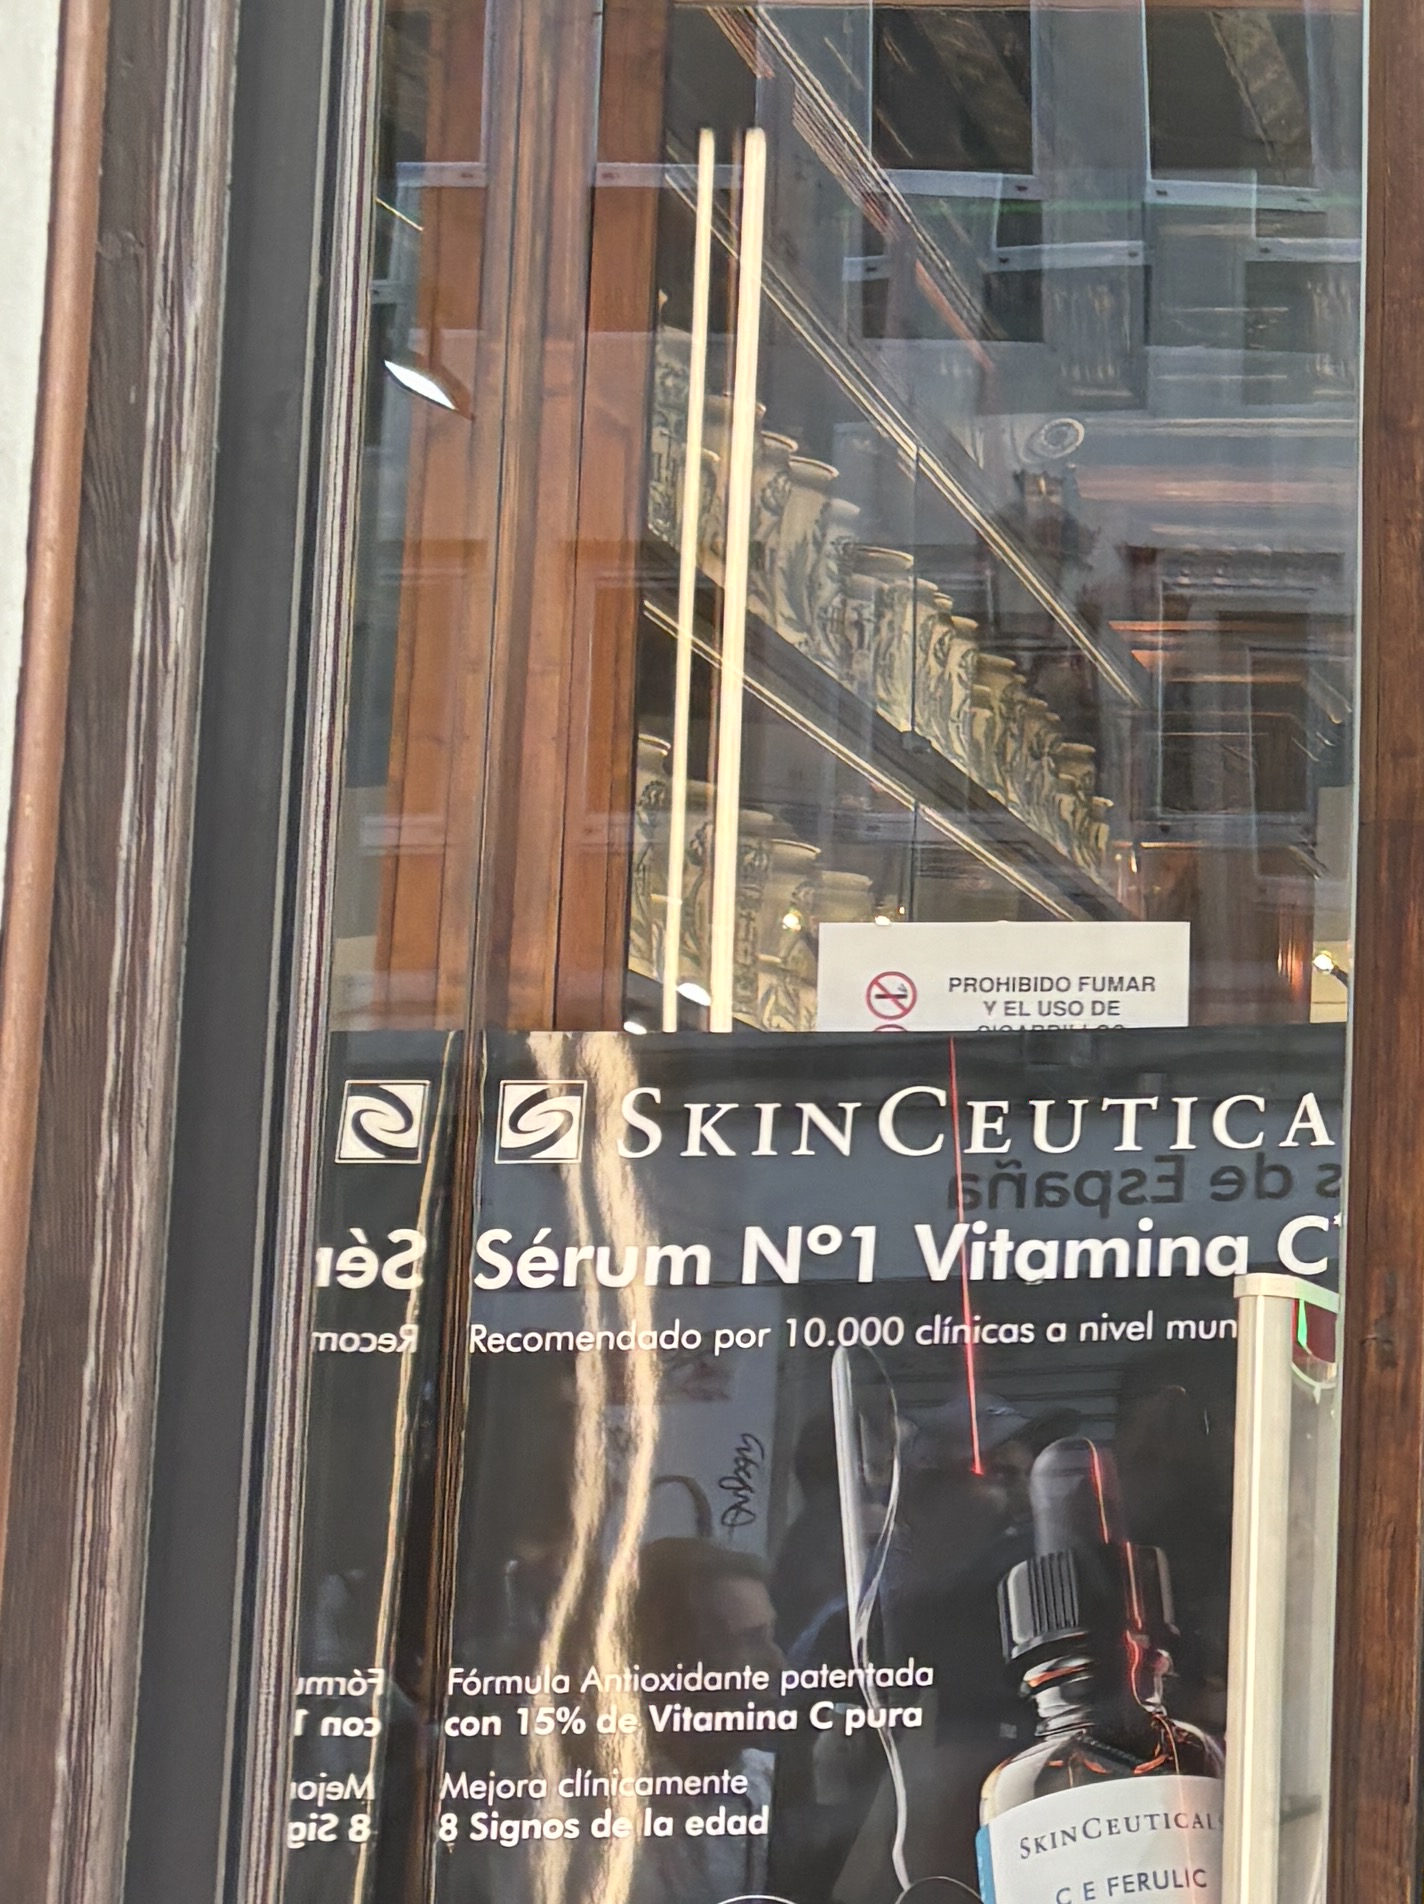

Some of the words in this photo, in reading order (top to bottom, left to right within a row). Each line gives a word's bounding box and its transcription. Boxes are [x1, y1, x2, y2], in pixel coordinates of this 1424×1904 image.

[948, 975, 1072, 995] PROHIBIDO
[1078, 975, 1156, 994] FUMAR
[983, 999, 997, 1018] Y
[1003, 999, 1032, 1018] EL
[1036, 999, 1085, 1018] USO
[1091, 999, 1120, 1017] DE
[474, 1226, 711, 1291] Sérum
[915, 1216, 1249, 1283] Vitamina
[469, 1317, 701, 1356] Recomendado
[714, 1324, 772, 1357] por
[786, 1316, 905, 1349] 10.000
[915, 1311, 1036, 1347] clínicas
[1046, 1322, 1067, 1344] a
[1079, 1309, 1154, 1343] nivel
[448, 1665, 571, 1697] Fórmula
[580, 1662, 770, 1696] Antioxidante
[780, 1663, 934, 1699] patentada
[444, 1710, 502, 1739] con
[517, 1707, 587, 1737] 15%
[596, 1704, 640, 1736] de
[649, 1701, 798, 1734] Vitamina
[808, 1701, 835, 1733] C
[845, 1704, 925, 1737] pura
[439, 1769, 548, 1808] Mejora
[558, 1767, 749, 1800] clínicamente
[438, 1813, 459, 1844] 8
[469, 1811, 583, 1848] Signos
[591, 1808, 632, 1840] de
[643, 1808, 675, 1838] la
[684, 1805, 770, 1837] edad
[1020, 1811, 1224, 1861] SKINCEUTICAL
[1082, 1880, 1097, 1902] E
[1107, 1868, 1209, 1898] FERULIC
